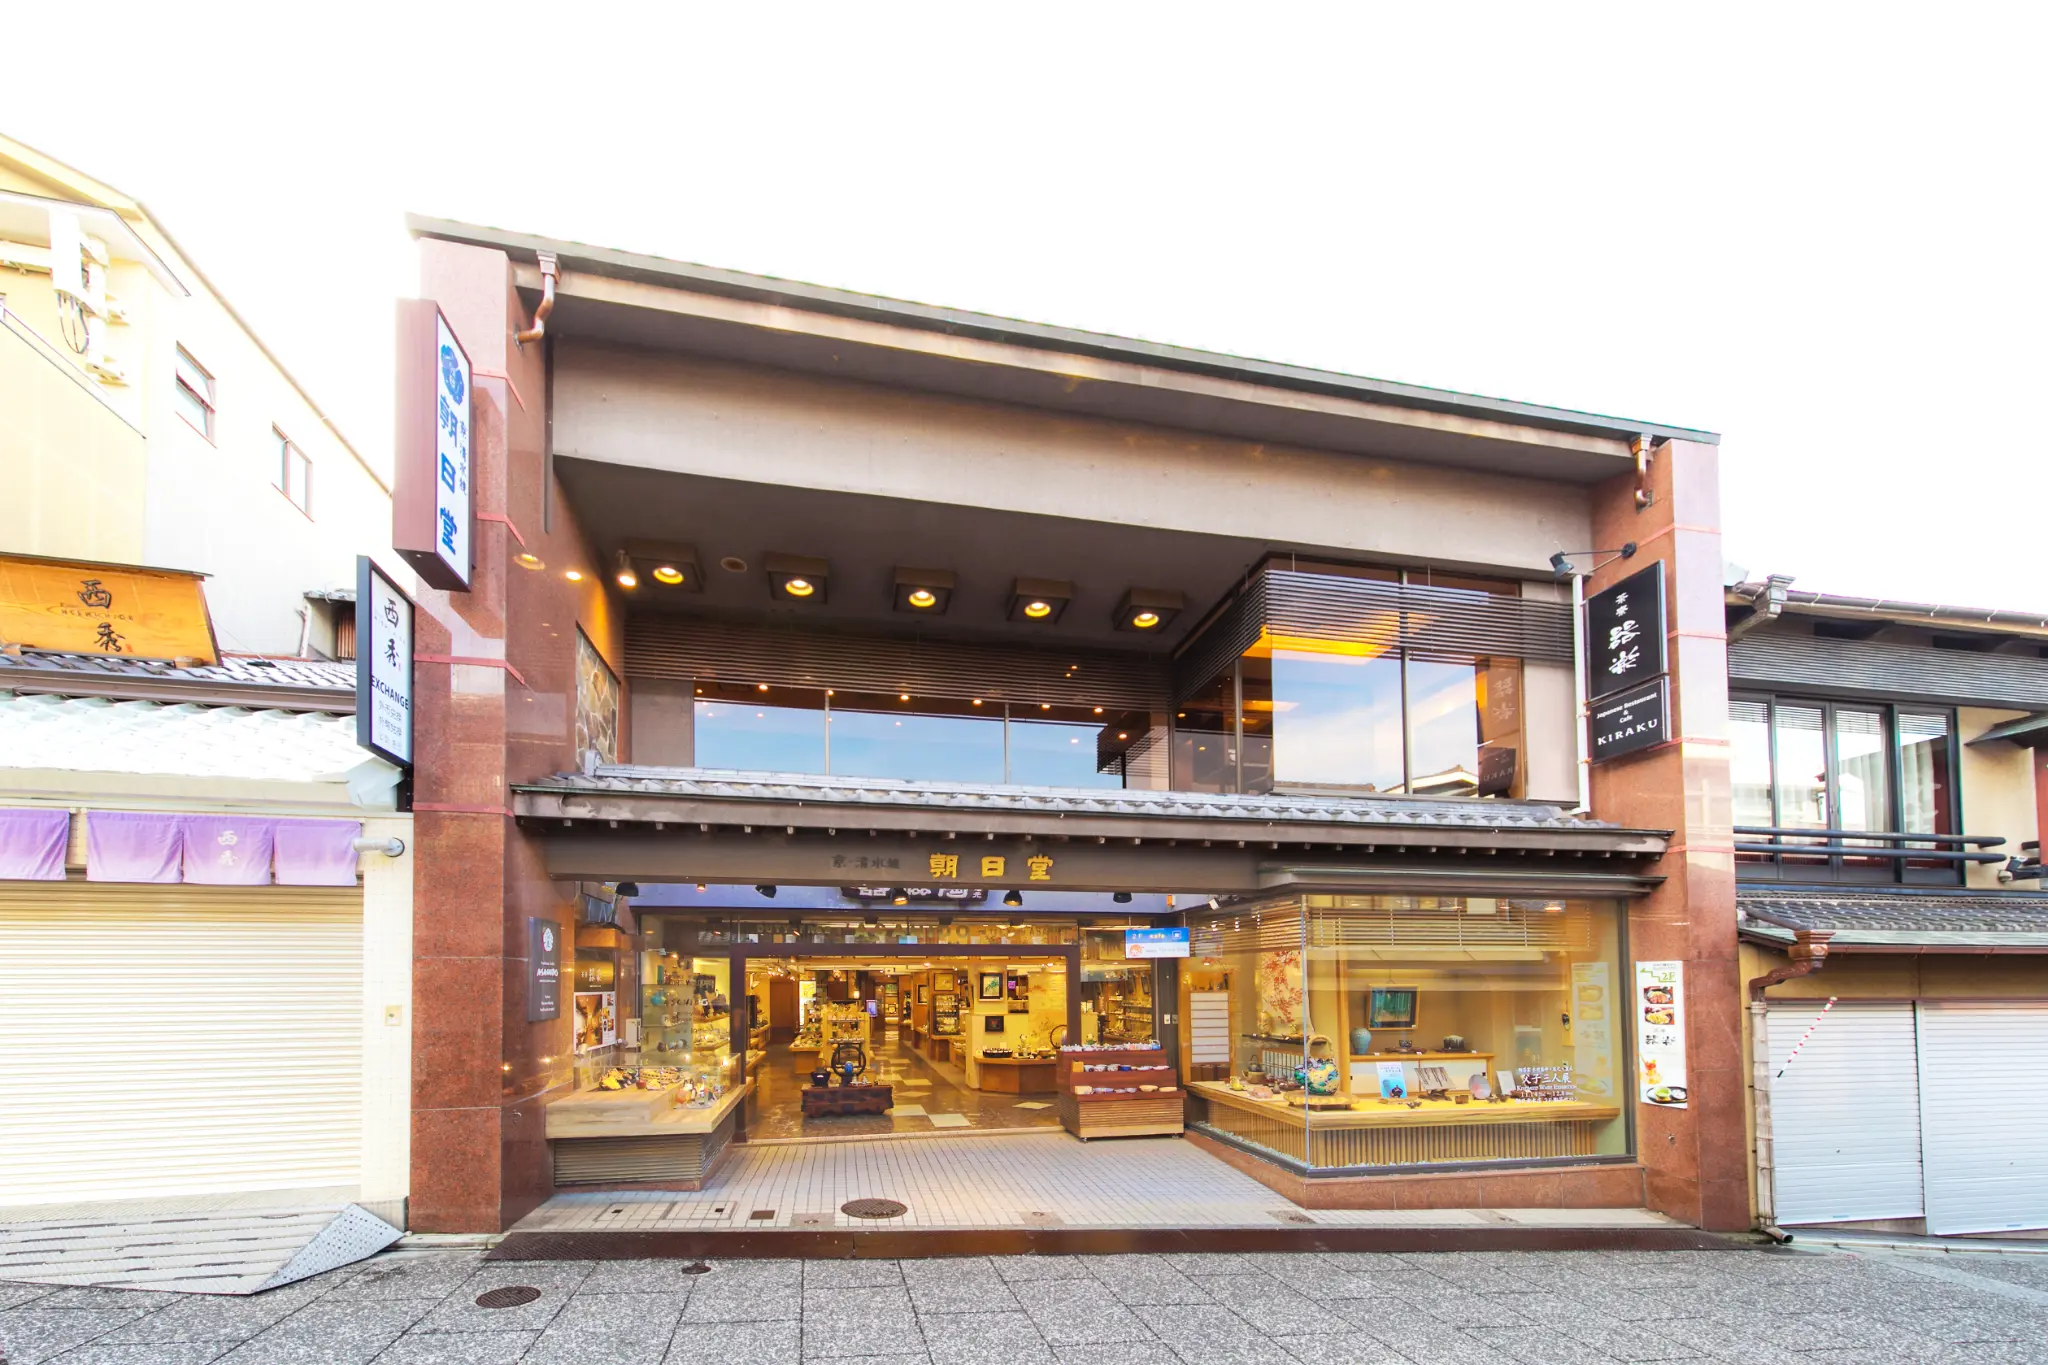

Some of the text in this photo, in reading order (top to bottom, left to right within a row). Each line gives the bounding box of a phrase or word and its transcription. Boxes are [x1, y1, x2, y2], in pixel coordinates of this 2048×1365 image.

[371, 675, 409, 711] EXCHANGE
[1596, 692, 1657, 719] Japanese Restaurant
[1597, 719, 1658, 746] KIRAKU
[929, 853, 1054, 881] 朝日堂
[1661, 972, 1675, 980] 2F
